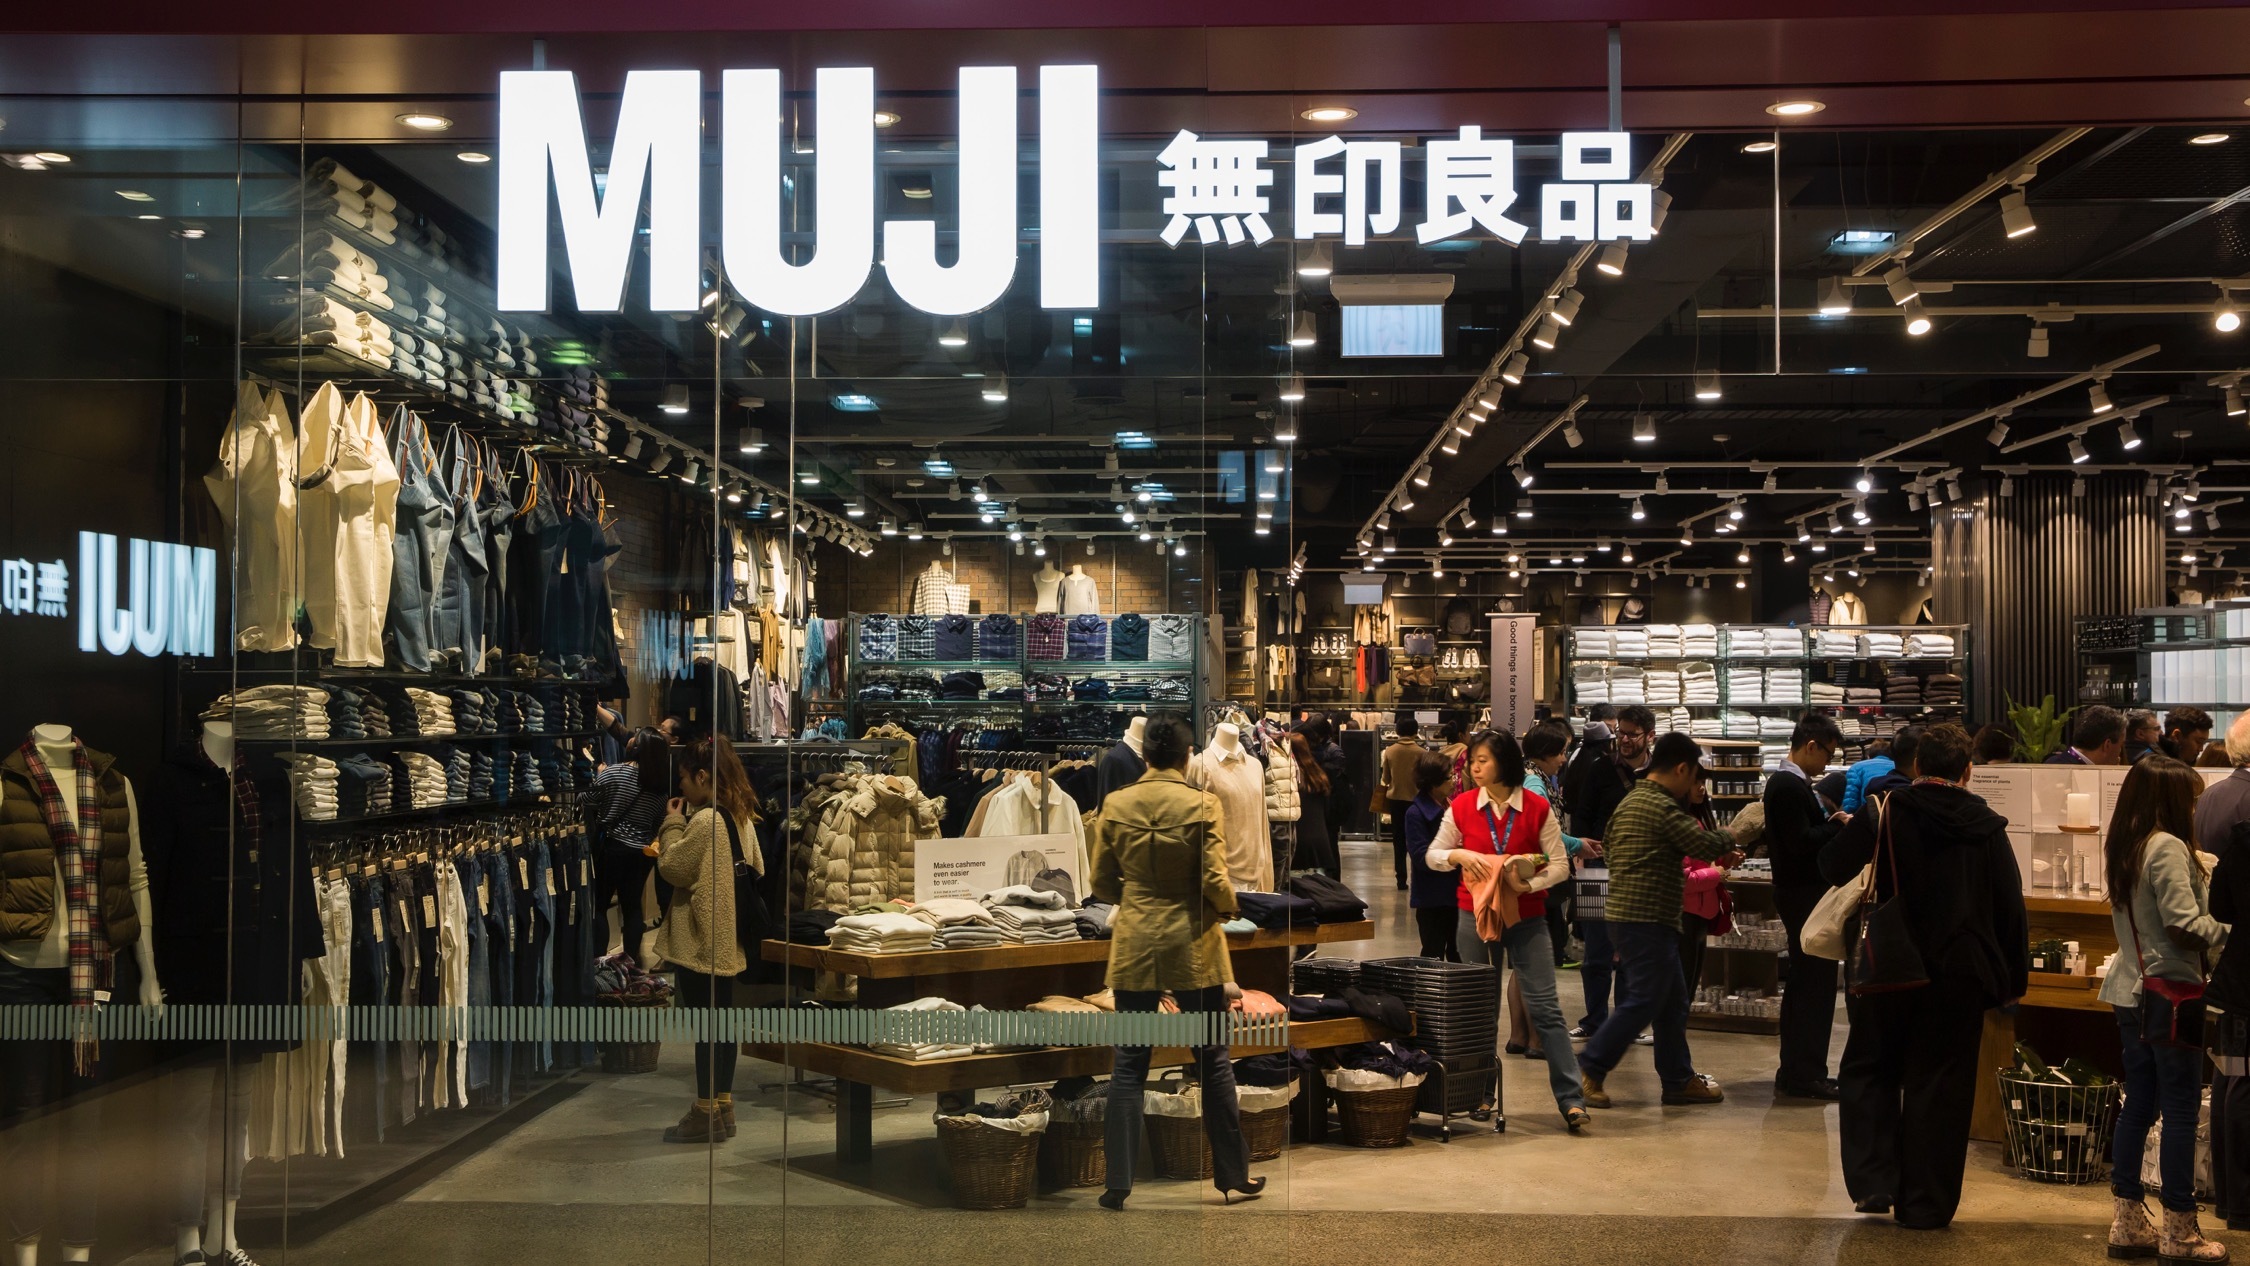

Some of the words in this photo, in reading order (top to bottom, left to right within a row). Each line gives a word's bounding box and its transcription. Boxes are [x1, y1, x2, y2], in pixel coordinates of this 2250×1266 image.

[497, 64, 1099, 316] MUJI
[1156, 125, 1653, 248] 無印良品
[1510, 620, 1518, 644] Good
[1508, 645, 1518, 672] things
[1510, 675, 1518, 686] for
[1509, 695, 1517, 711] bon
[933, 861, 955, 869] Makes
[955, 860, 986, 868] cashmere
[950, 869, 970, 877] easier
